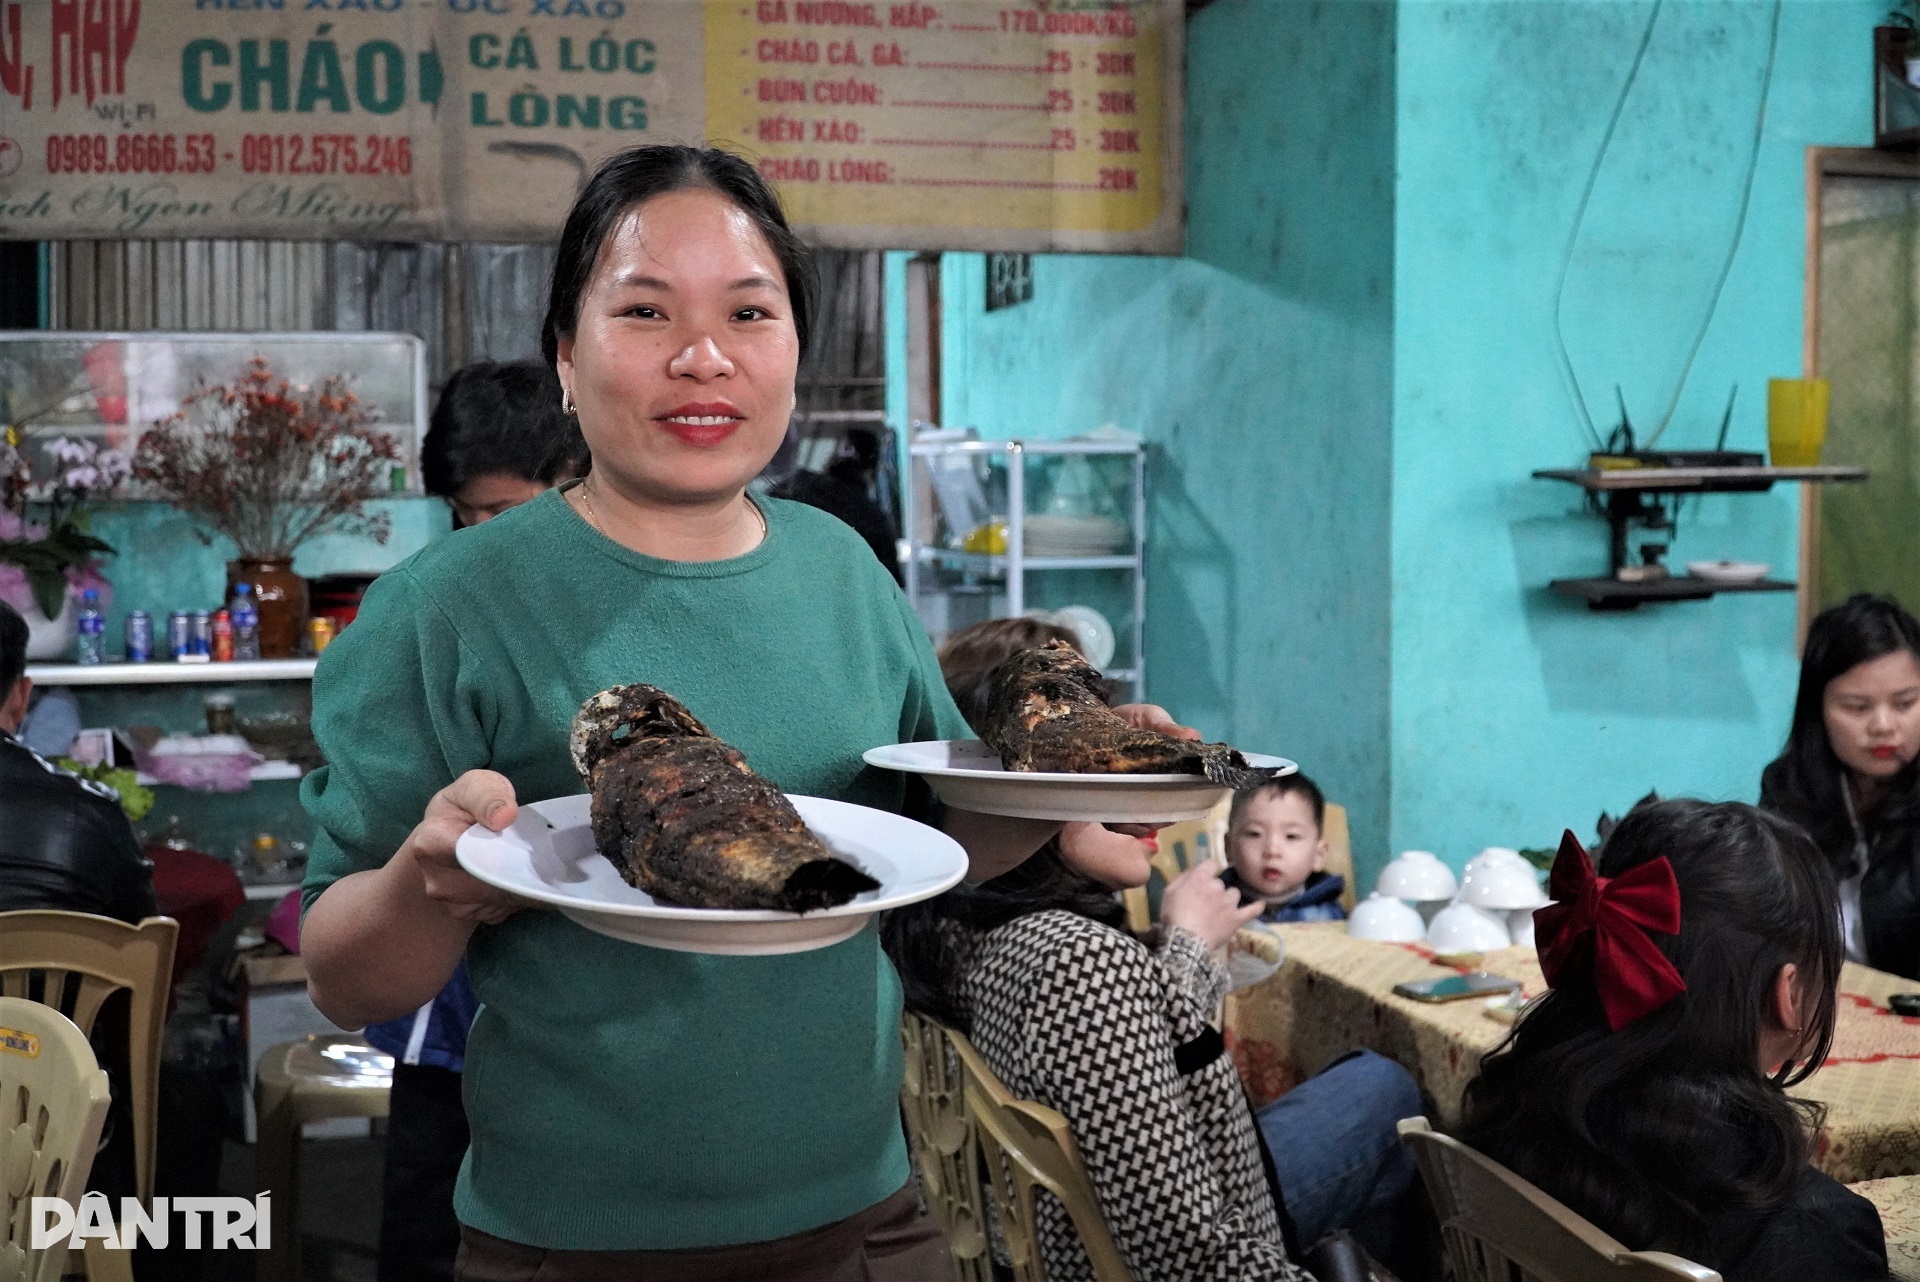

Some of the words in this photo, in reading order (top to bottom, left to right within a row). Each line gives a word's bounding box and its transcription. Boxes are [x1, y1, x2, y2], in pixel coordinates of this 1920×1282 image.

[468, 25, 539, 70] CÁ
[559, 29, 656, 74] LÓC
[1097, 52, 1136, 75] 30K
[182, 23, 408, 115] CHÁO
[1097, 91, 1136, 115] 30K
[46, 134, 217, 175] 0989.8666.53
[241, 134, 412, 175] 0912.575.246
[1099, 130, 1141, 153] 30K
